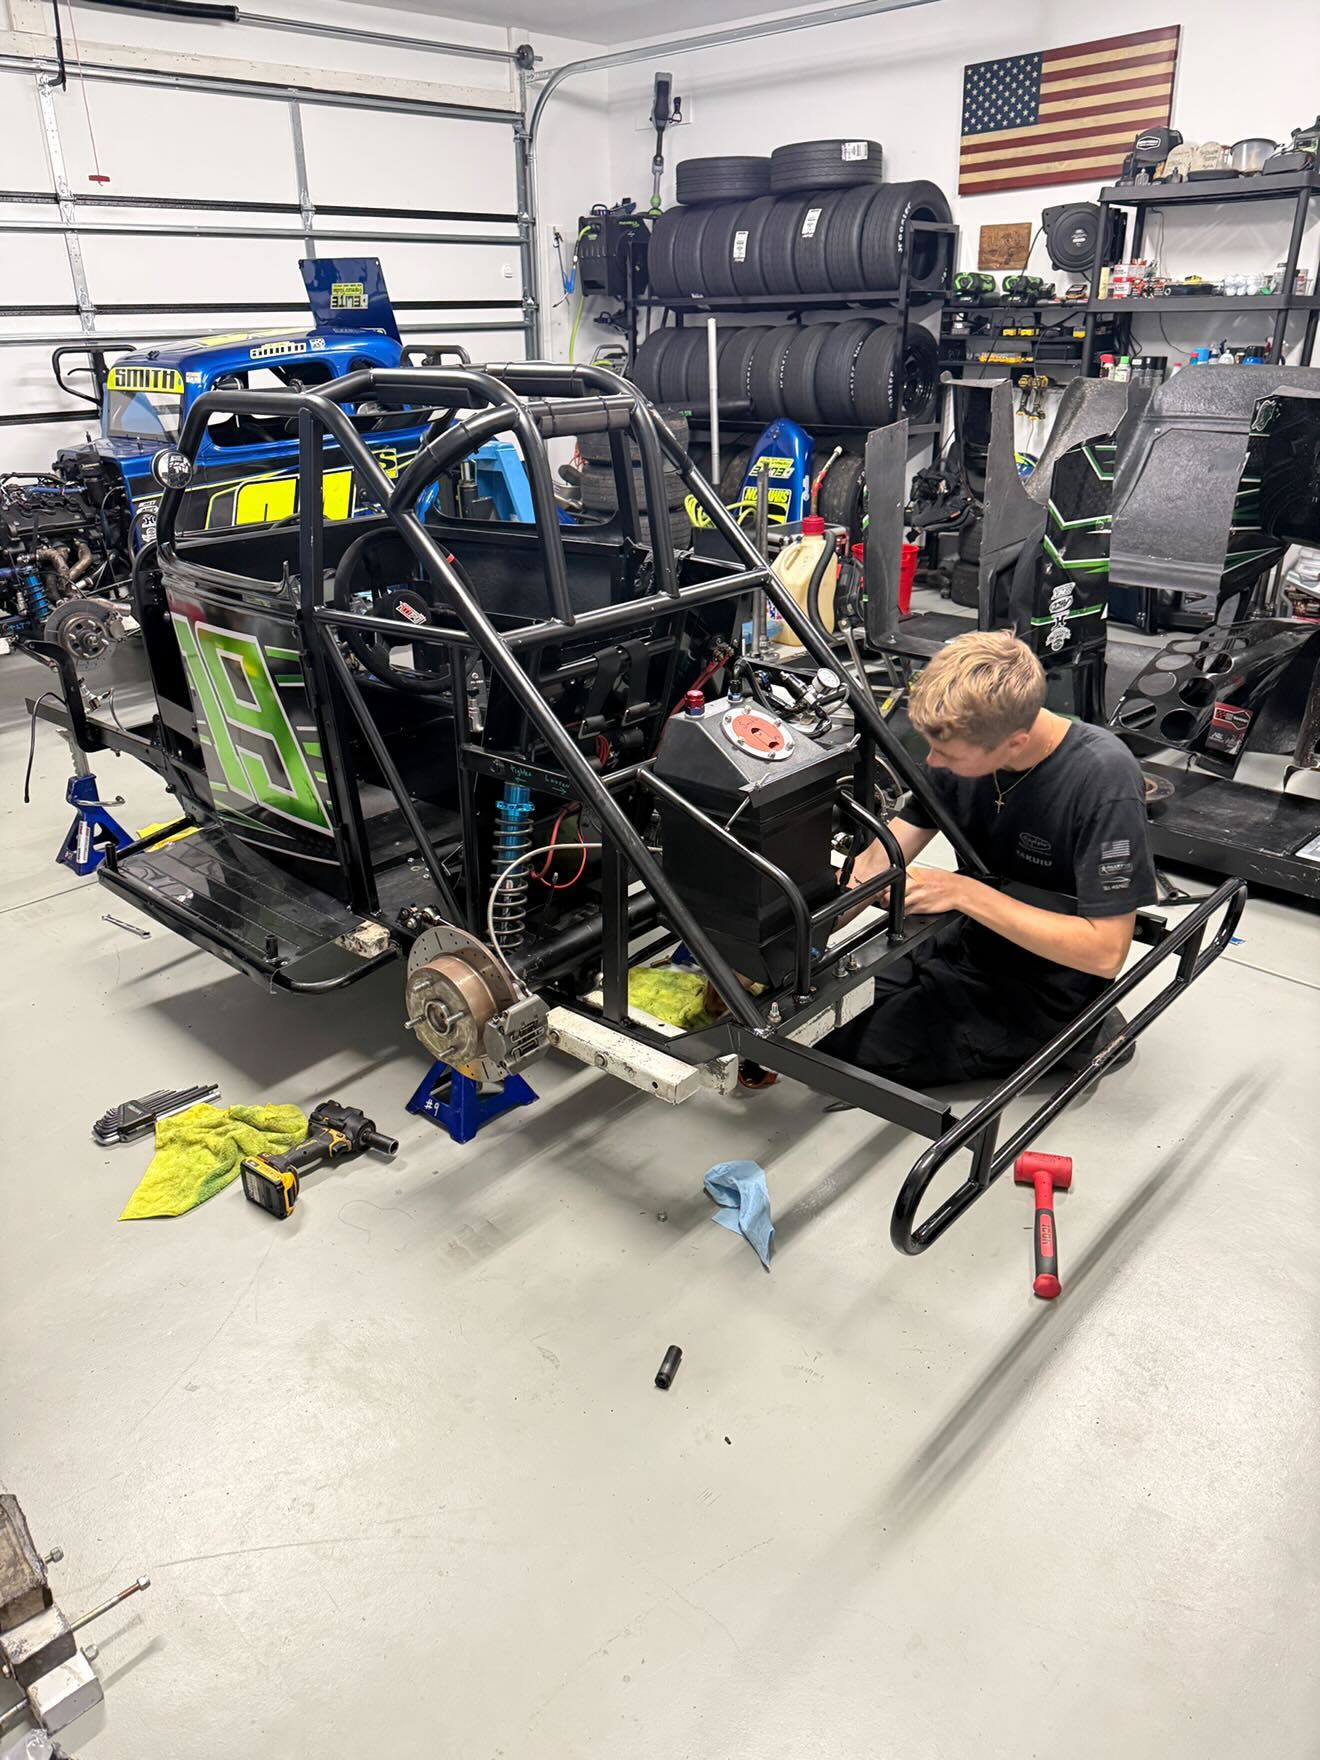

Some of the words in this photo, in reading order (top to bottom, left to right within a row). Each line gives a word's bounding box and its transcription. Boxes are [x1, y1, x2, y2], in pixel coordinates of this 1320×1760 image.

[115, 369, 175, 389] SMITH
[751, 466, 786, 477] ELE
[424, 1098, 440, 1117] #9
